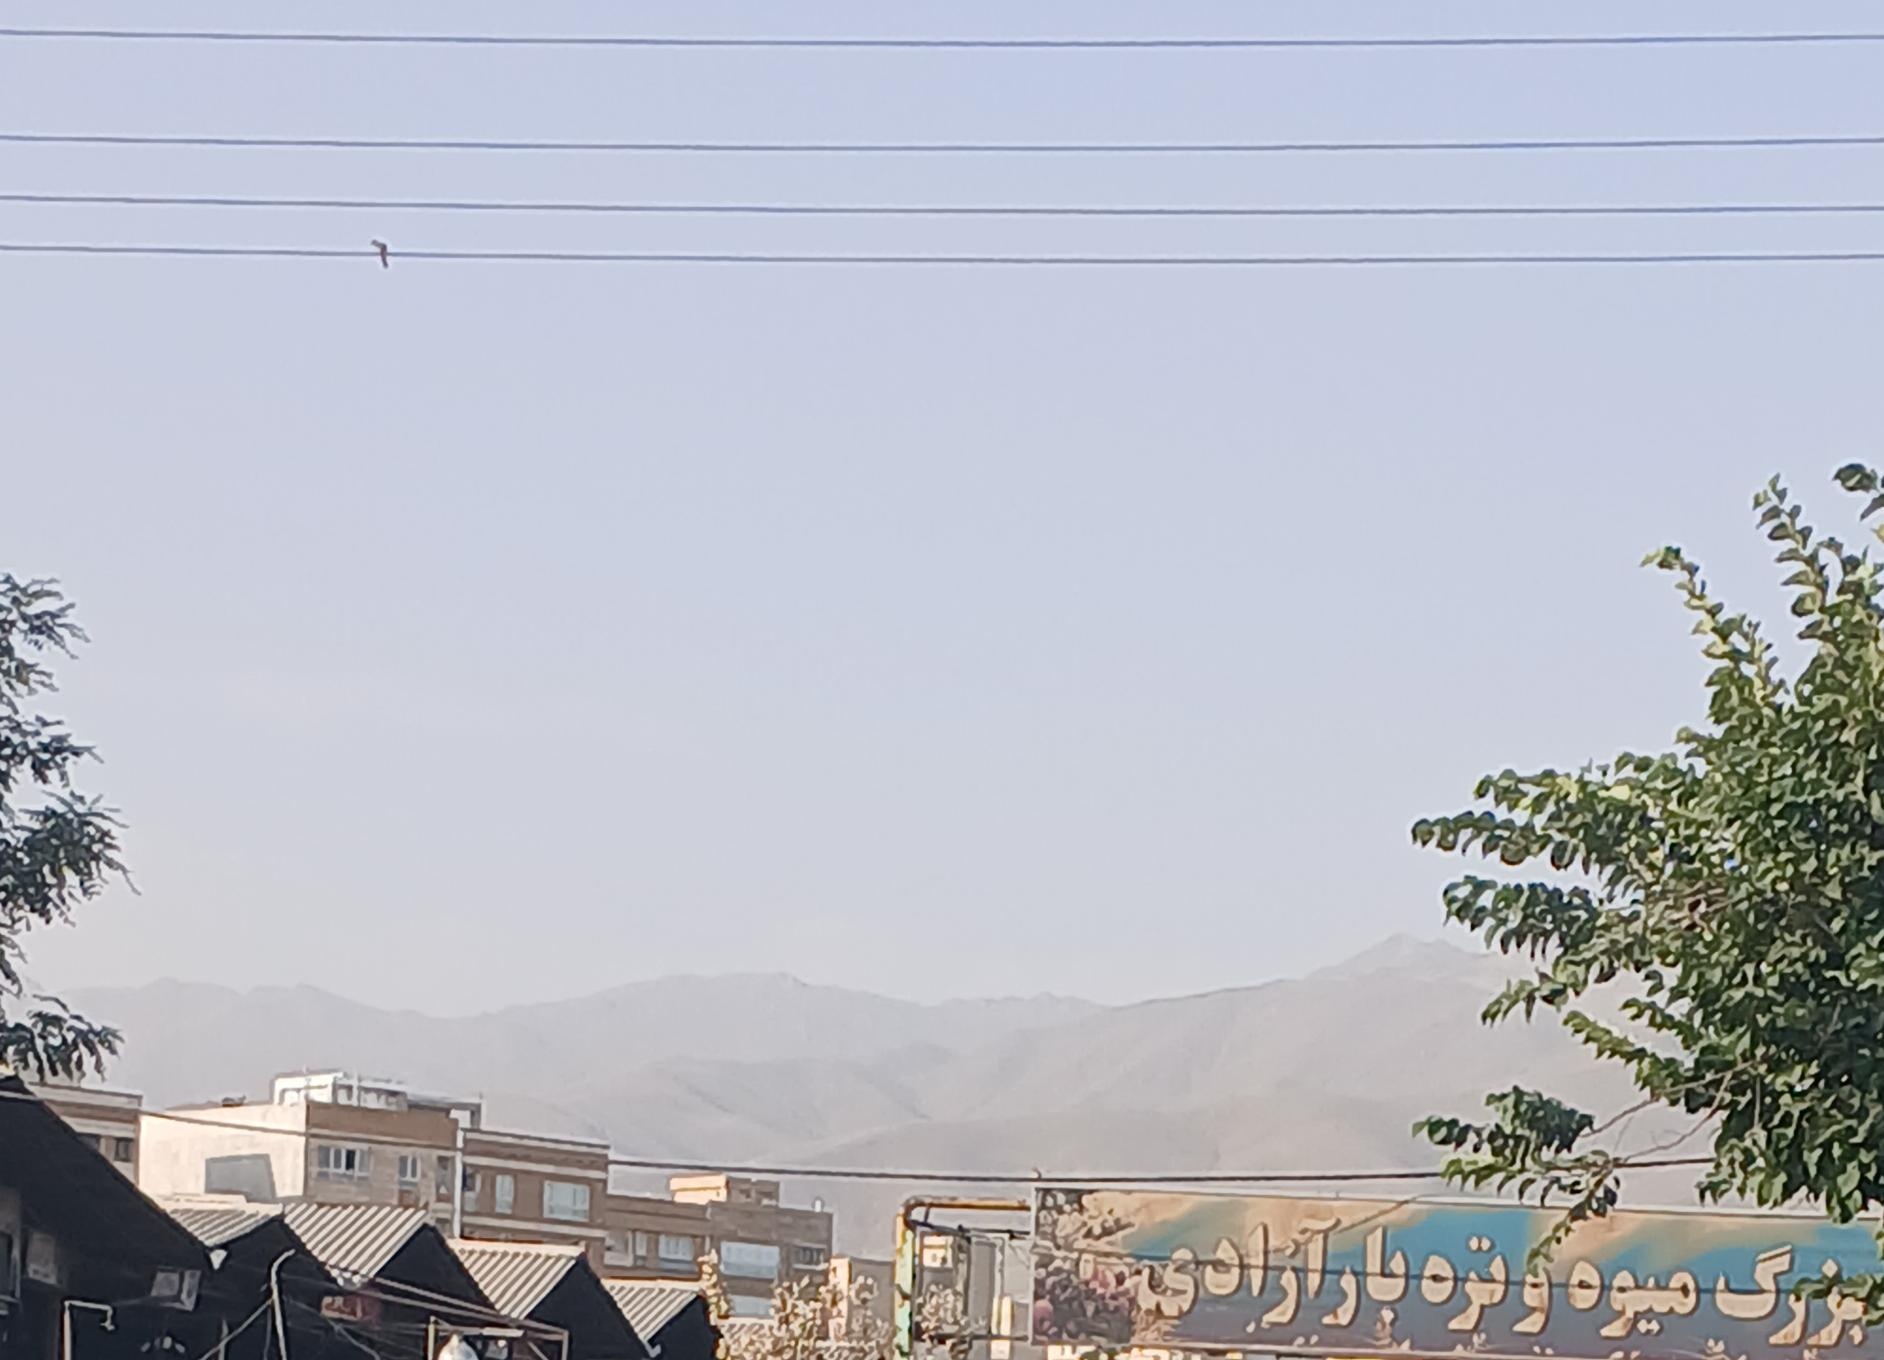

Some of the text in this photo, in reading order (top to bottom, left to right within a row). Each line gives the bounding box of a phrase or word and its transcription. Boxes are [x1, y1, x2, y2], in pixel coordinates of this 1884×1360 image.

[1136, 1217, 1342, 1328] آزادی
[1512, 1266, 1550, 1335] و
[1568, 1260, 1698, 1338] میوه
[1715, 1244, 1867, 1347] بزرگ
